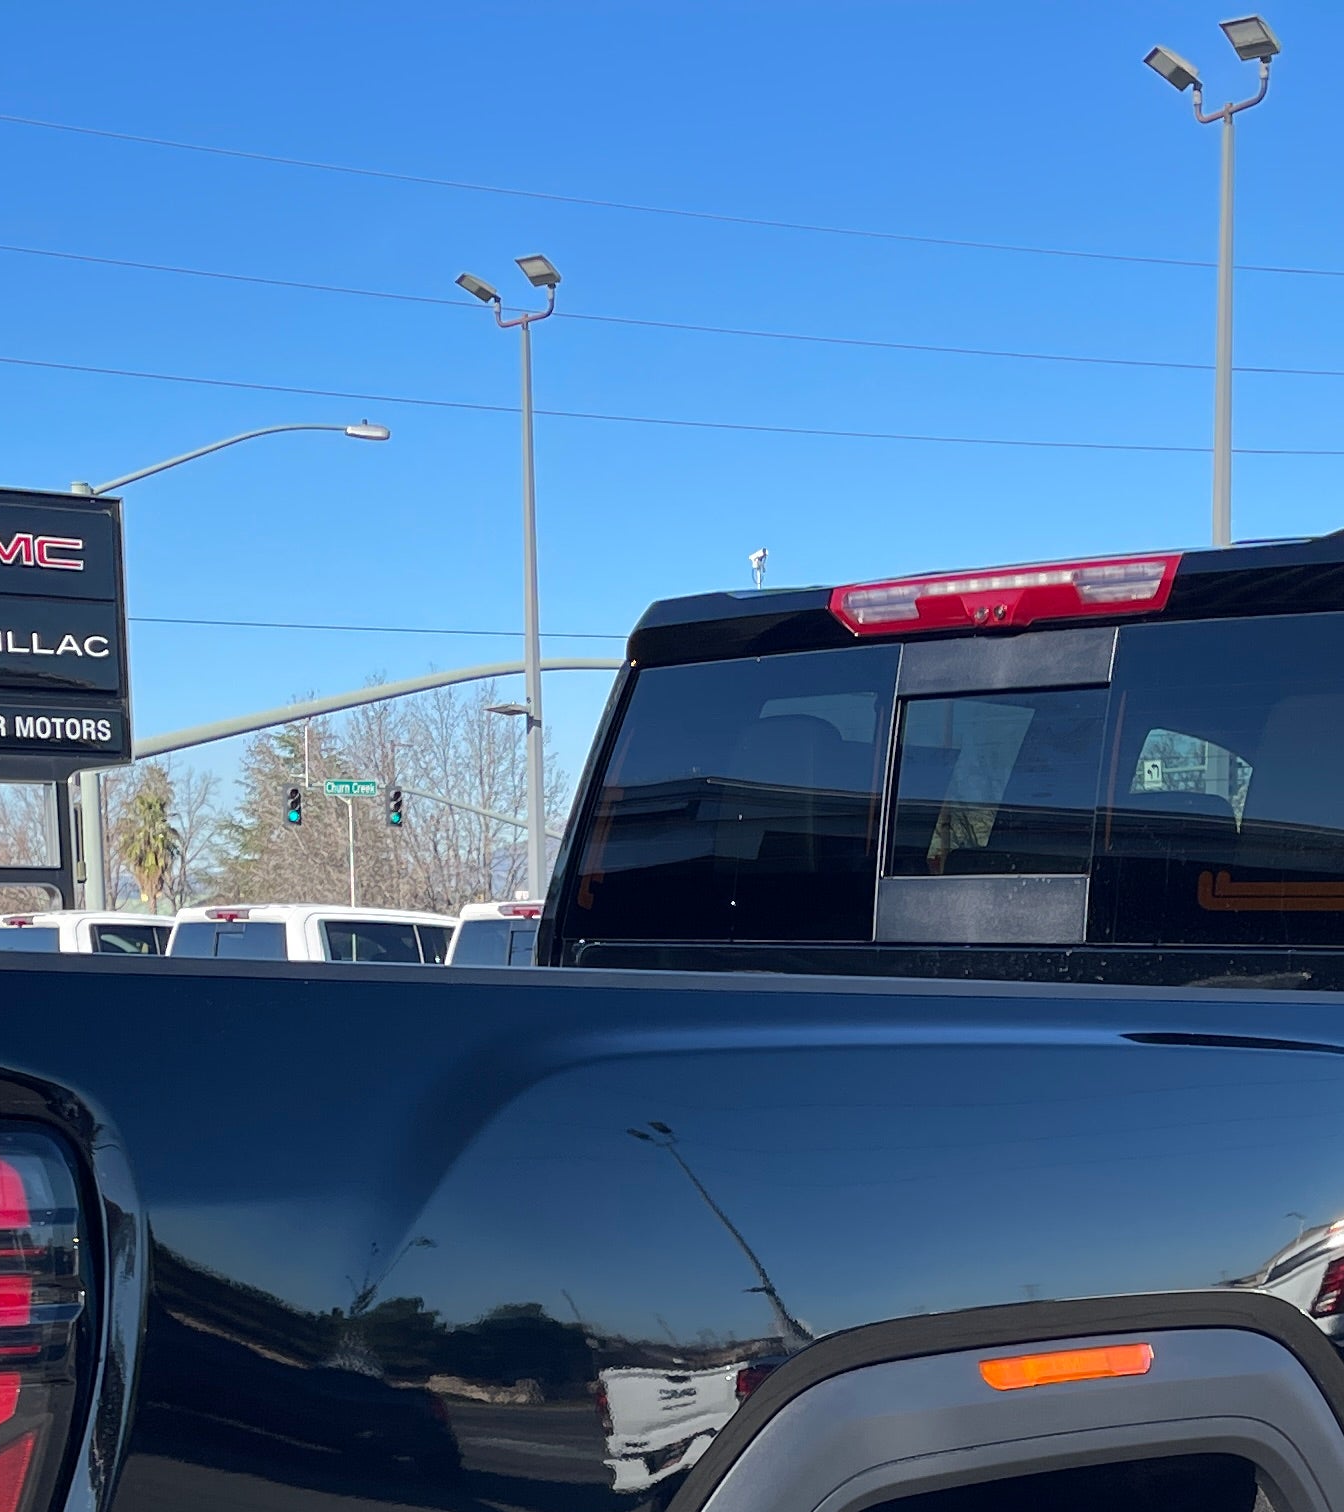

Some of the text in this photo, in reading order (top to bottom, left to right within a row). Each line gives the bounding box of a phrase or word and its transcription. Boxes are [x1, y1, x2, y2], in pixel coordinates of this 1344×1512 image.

[15, 716, 112, 741] MOTORS
[326, 781, 375, 793] Churn Creek
